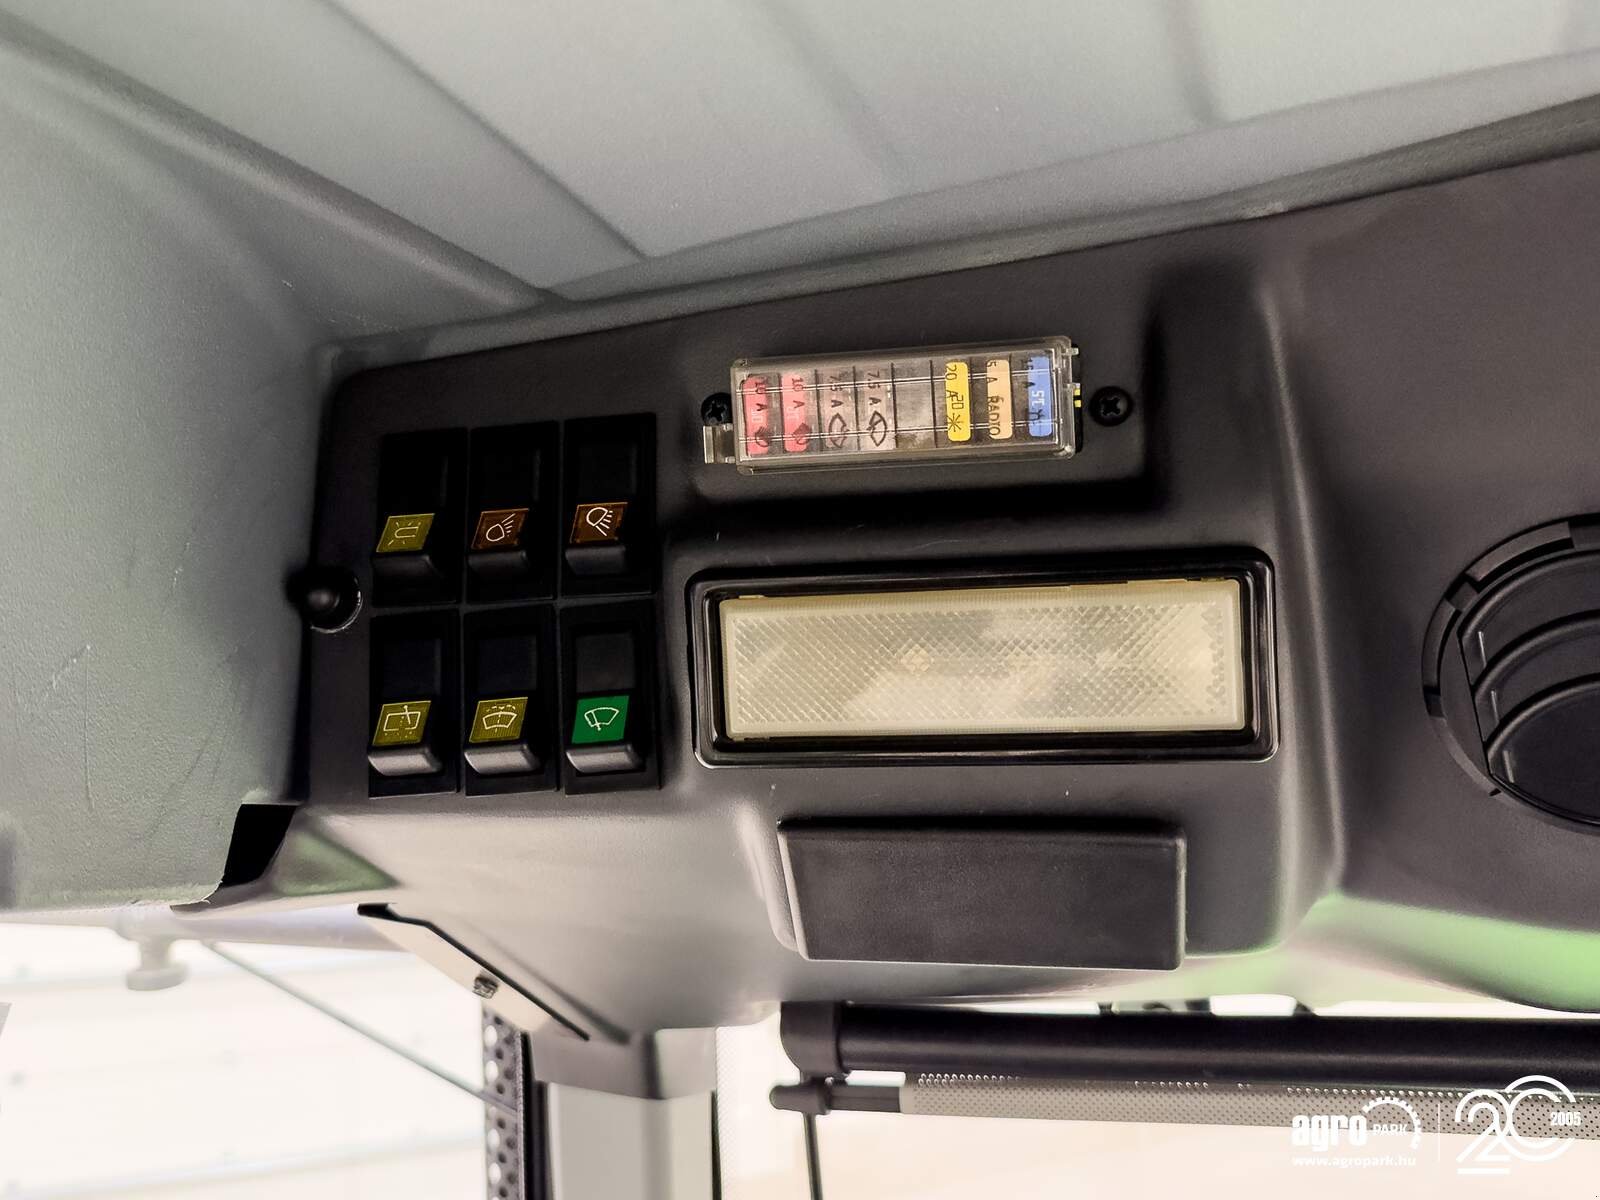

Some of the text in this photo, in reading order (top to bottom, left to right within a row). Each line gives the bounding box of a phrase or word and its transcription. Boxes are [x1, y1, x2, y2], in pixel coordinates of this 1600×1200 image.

[945, 364, 958, 381] 20
[986, 376, 998, 384] A
[791, 377, 806, 409] 10 A
[831, 399, 844, 408] A
[869, 396, 882, 406] A
[756, 402, 768, 412] A
[987, 395, 1001, 436] RADIO
